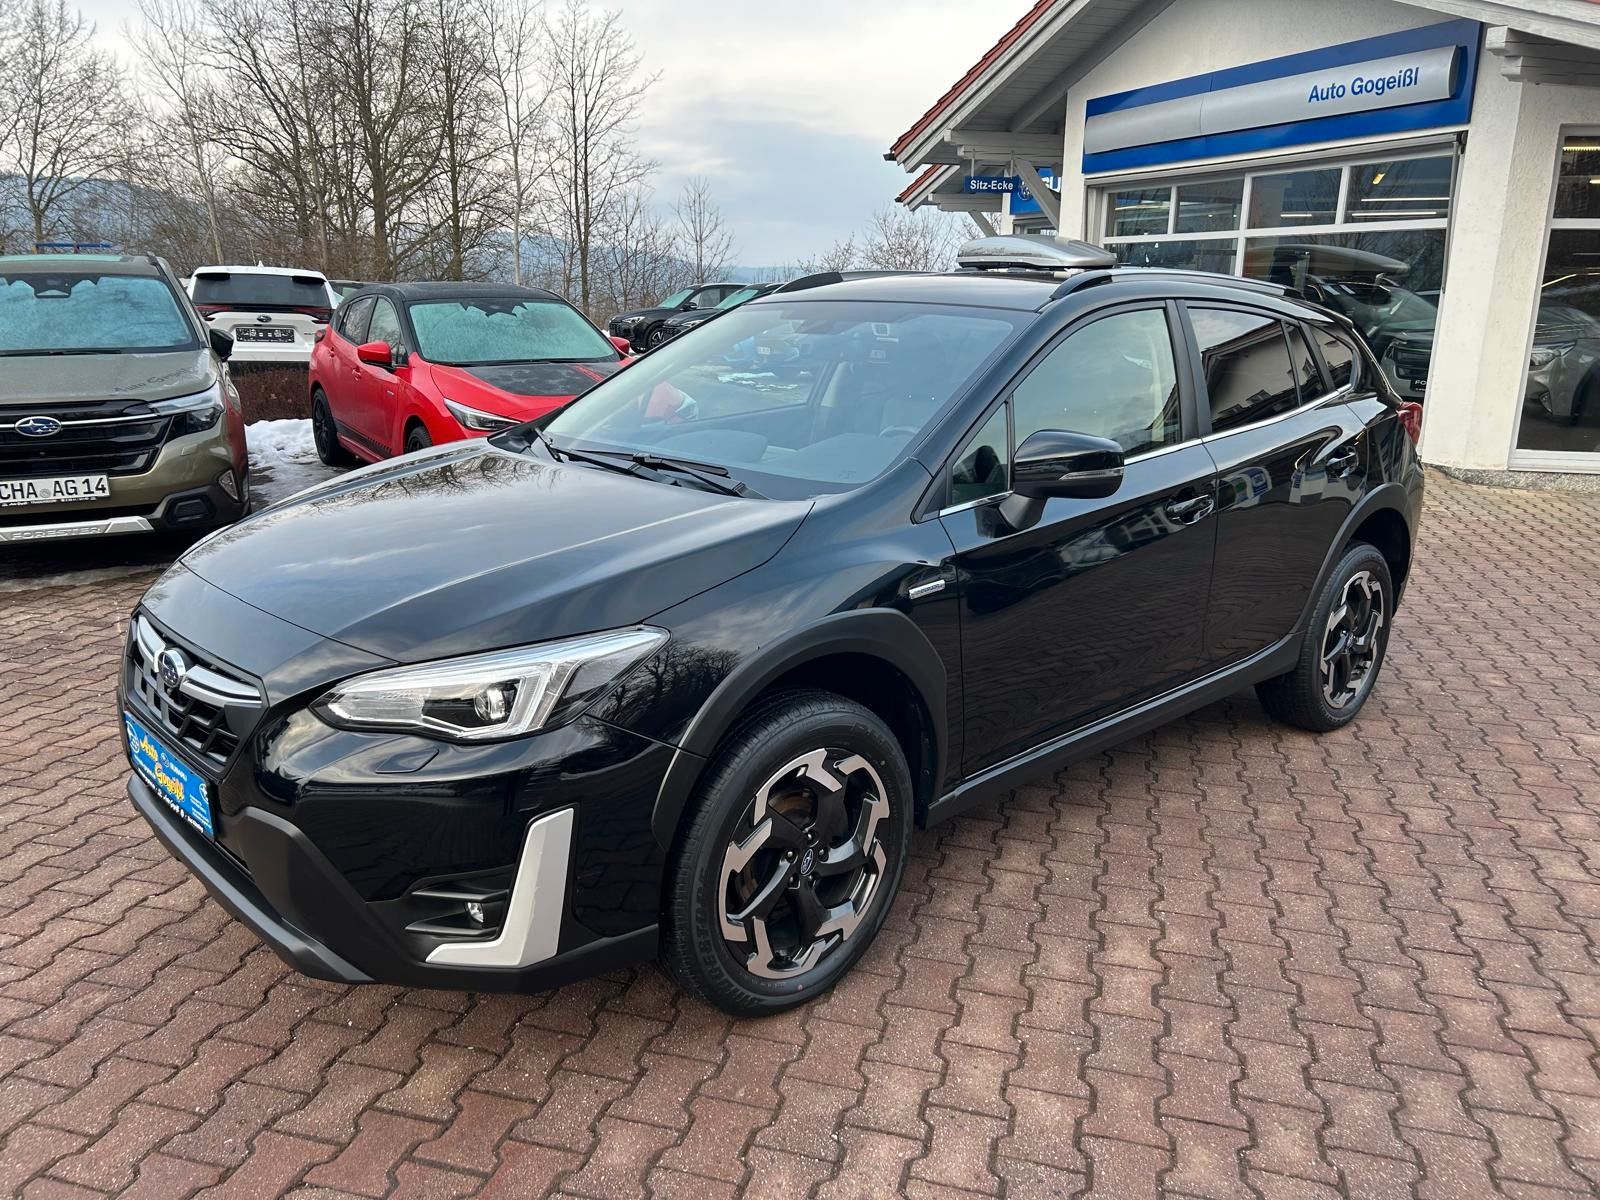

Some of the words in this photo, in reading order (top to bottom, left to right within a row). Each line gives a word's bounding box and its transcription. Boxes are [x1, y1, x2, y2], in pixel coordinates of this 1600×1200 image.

[1308, 83, 1346, 103] Auto
[1351, 67, 1419, 96] Gogeißl
[970, 179, 1014, 190] Sitz-Ecke
[0, 482, 39, 500] CHA
[53, 479, 78, 497] AG
[82, 477, 107, 494] 14
[12, 527, 102, 541] FORESTER
